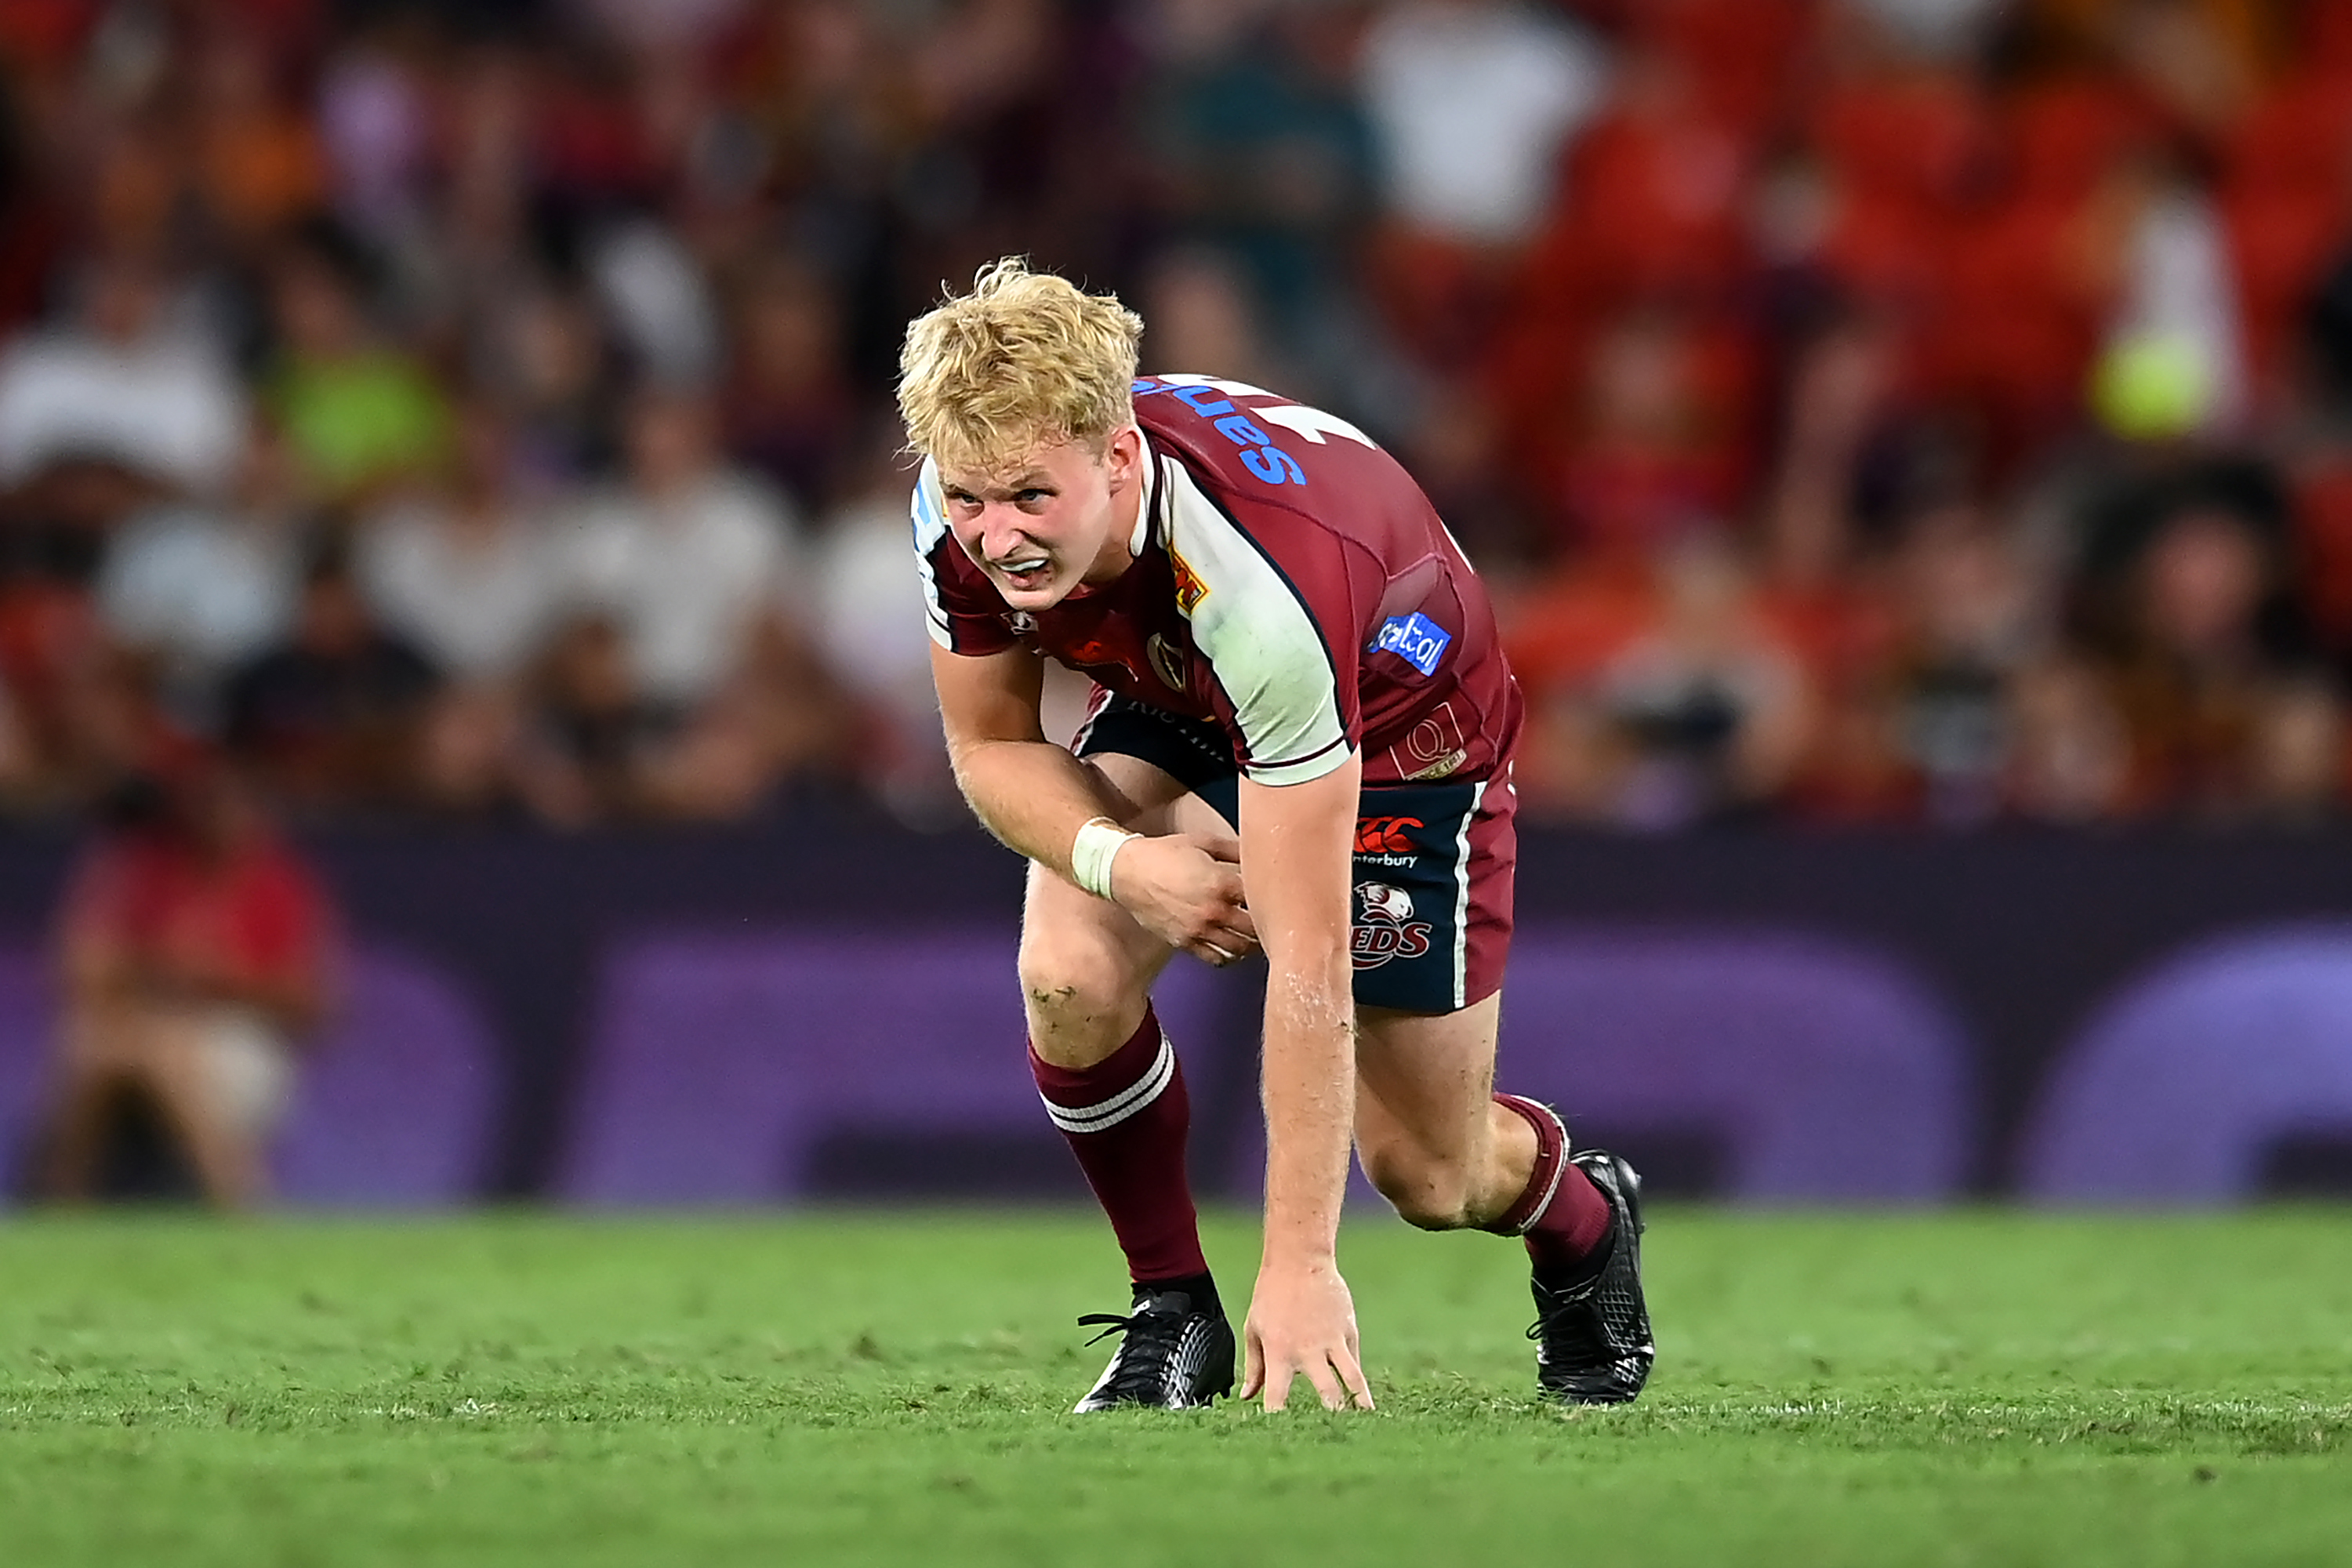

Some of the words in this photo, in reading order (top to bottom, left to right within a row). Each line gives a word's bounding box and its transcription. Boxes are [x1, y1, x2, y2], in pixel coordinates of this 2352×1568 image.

[1406, 719, 1450, 762] Q
[1352, 853, 1418, 869] nterbury
[1350, 922, 1433, 958] EDS
